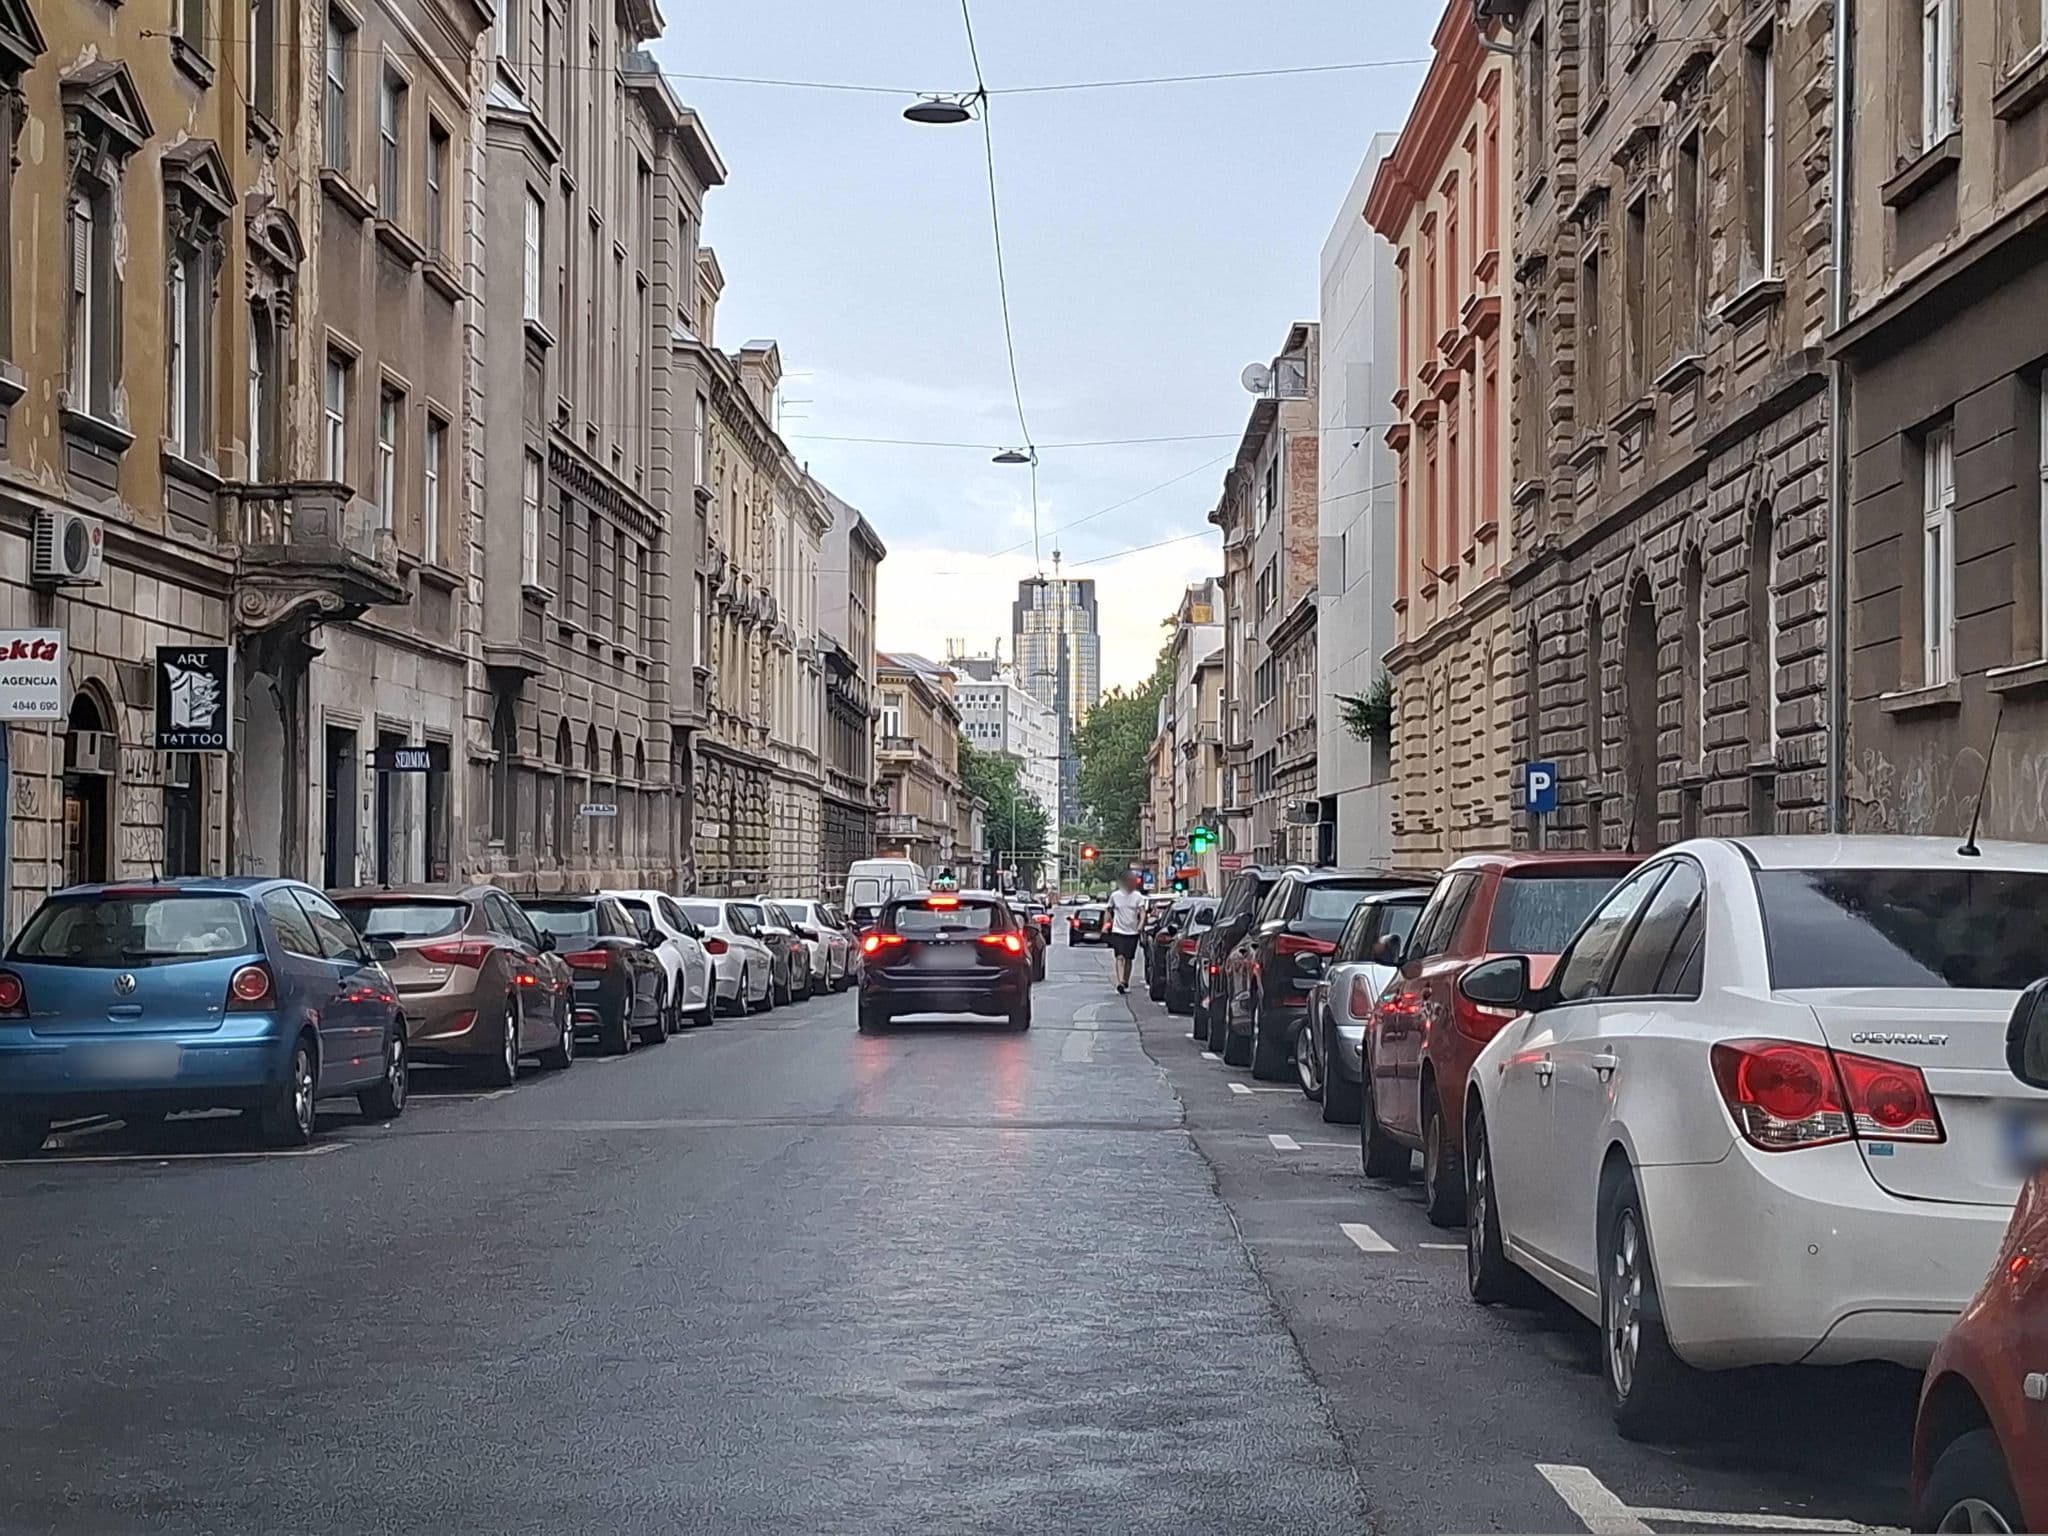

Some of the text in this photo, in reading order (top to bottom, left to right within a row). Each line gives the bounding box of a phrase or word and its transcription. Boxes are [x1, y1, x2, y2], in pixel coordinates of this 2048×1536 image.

[177, 653, 209, 668] ART
[160, 733, 223, 745] TATTOO
[1530, 772, 1550, 803] P
[1851, 1032, 1949, 1046] CHEVROLET
